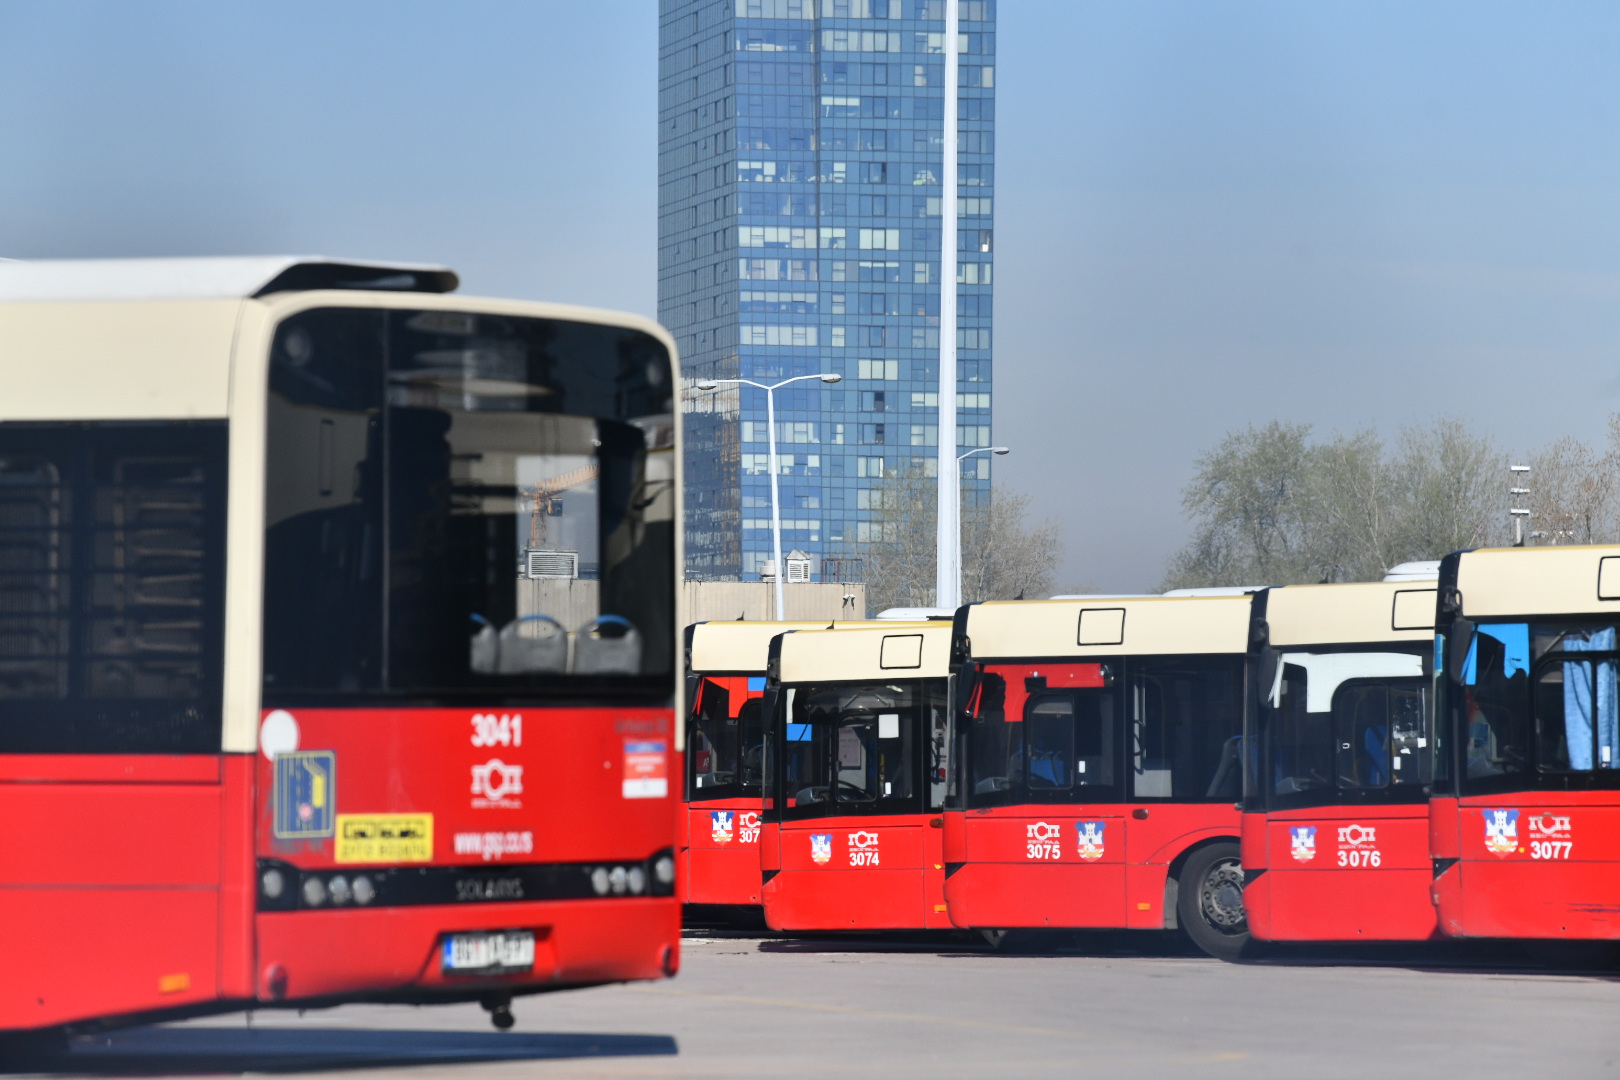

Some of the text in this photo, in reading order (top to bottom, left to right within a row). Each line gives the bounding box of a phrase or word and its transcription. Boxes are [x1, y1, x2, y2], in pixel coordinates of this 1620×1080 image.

[471, 713, 522, 747] 3041
[739, 830, 760, 843] 307
[1026, 844, 1060, 859] 3075
[1530, 840, 1573, 859] 3077
[849, 852, 880, 866] 3074
[1337, 850, 1381, 867] 3076
